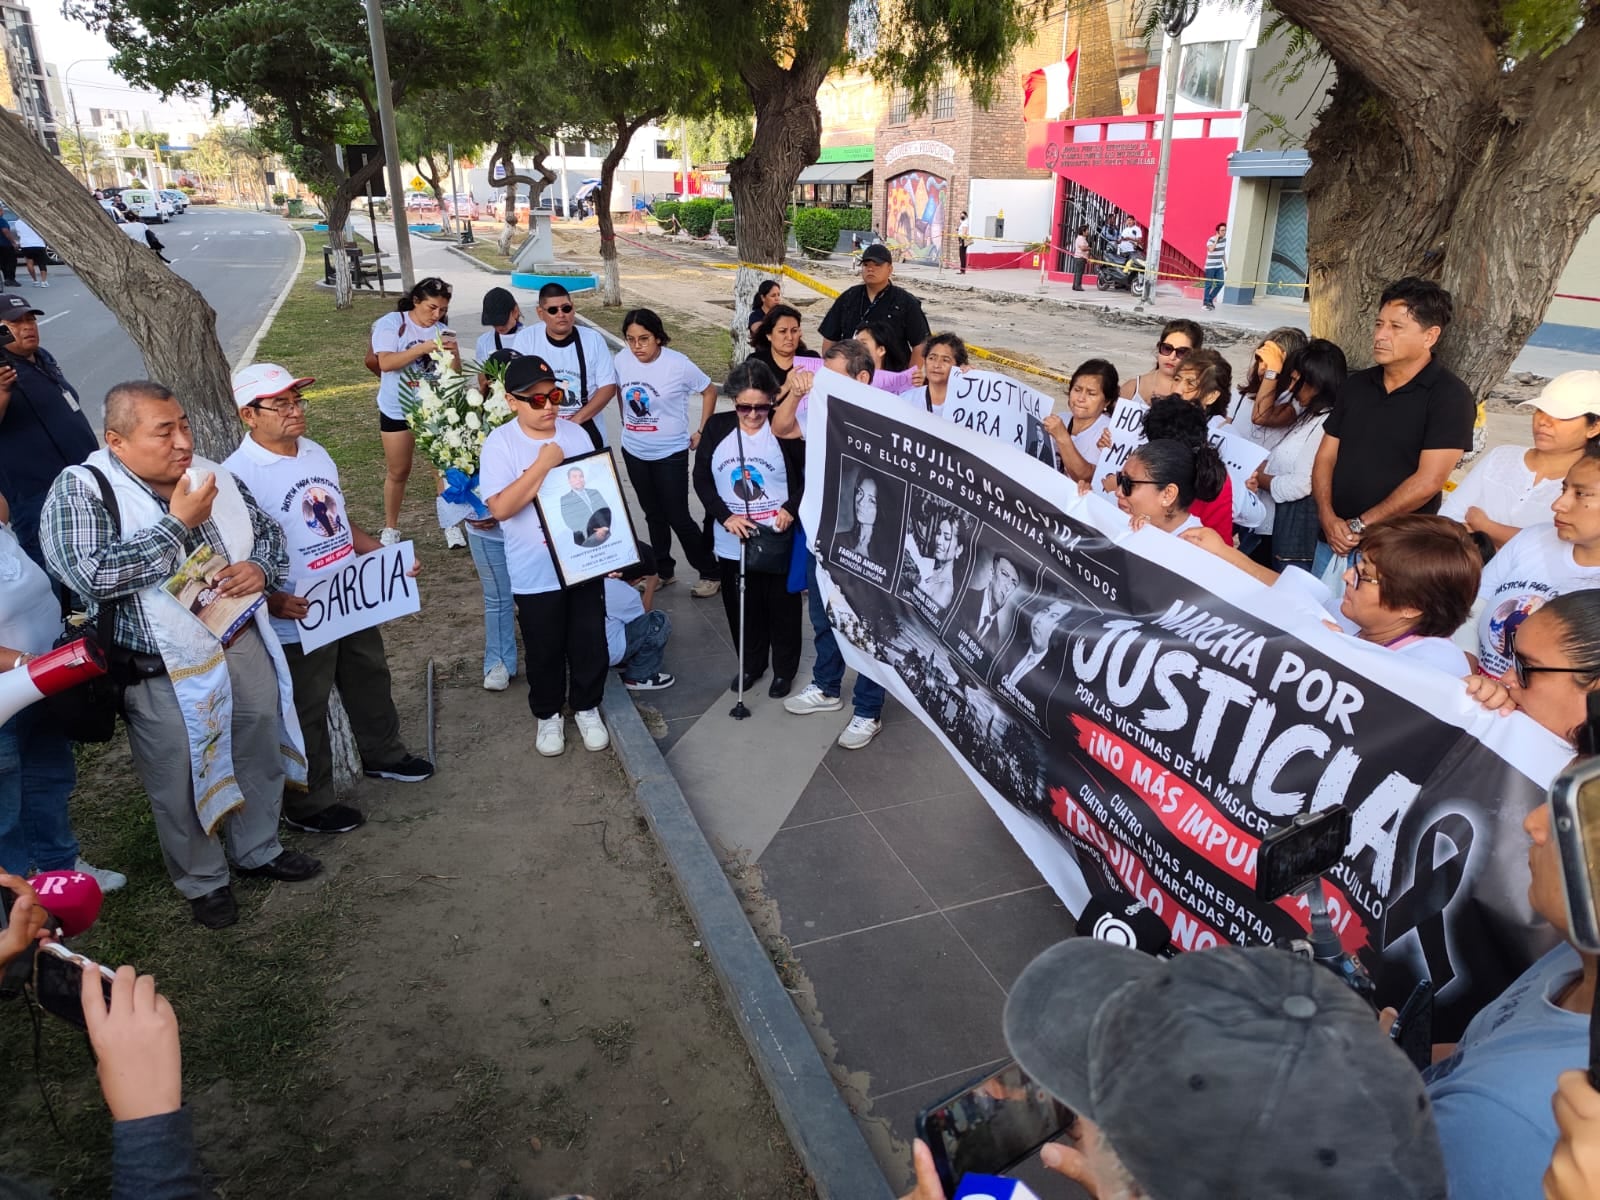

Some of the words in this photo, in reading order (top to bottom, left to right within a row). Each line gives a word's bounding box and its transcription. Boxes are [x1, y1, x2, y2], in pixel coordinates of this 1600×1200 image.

[953, 408, 1000, 437] PARA
[847, 435, 872, 455] POR
[929, 469, 954, 491] POR
[959, 485, 983, 506] SUS
[1050, 543, 1072, 568] POR
[1076, 562, 1117, 601] TODOS
[891, 432, 975, 484] TRUJILLO
[982, 478, 1005, 502] NO
[1015, 499, 1082, 552] OLVIDA
[299, 550, 410, 631] GARCIA
[862, 557, 887, 577] ANDREA
[958, 628, 970, 645] LUIS
[968, 638, 984, 660] ROJAS
[1151, 599, 1268, 679] MARCHA
[1269, 650, 1365, 736] POR
[1072, 618, 1422, 898] JUSTICIA
[1075, 682, 1093, 708] POR
[1092, 697, 1113, 723] LAS
[1115, 714, 1172, 762] VÍCTIMAS
[1173, 754, 1193, 777] DE
[1195, 768, 1212, 792] LA
[1329, 861, 1384, 920] RUJILLO
[1088, 730, 1125, 771] ¡NO
[1130, 759, 1184, 814] MÁS
[1065, 796, 1165, 917] TRUJILLO
[1171, 910, 1218, 951] NO
[1079, 784, 1109, 824] CUATRO
[1107, 817, 1154, 868] FAMILIAS
[1154, 865, 1225, 928] MARCADAS
[1110, 793, 1143, 838] CUATRO
[1144, 831, 1182, 873] VIDAS
[1183, 869, 1275, 947] ARREBATAD
